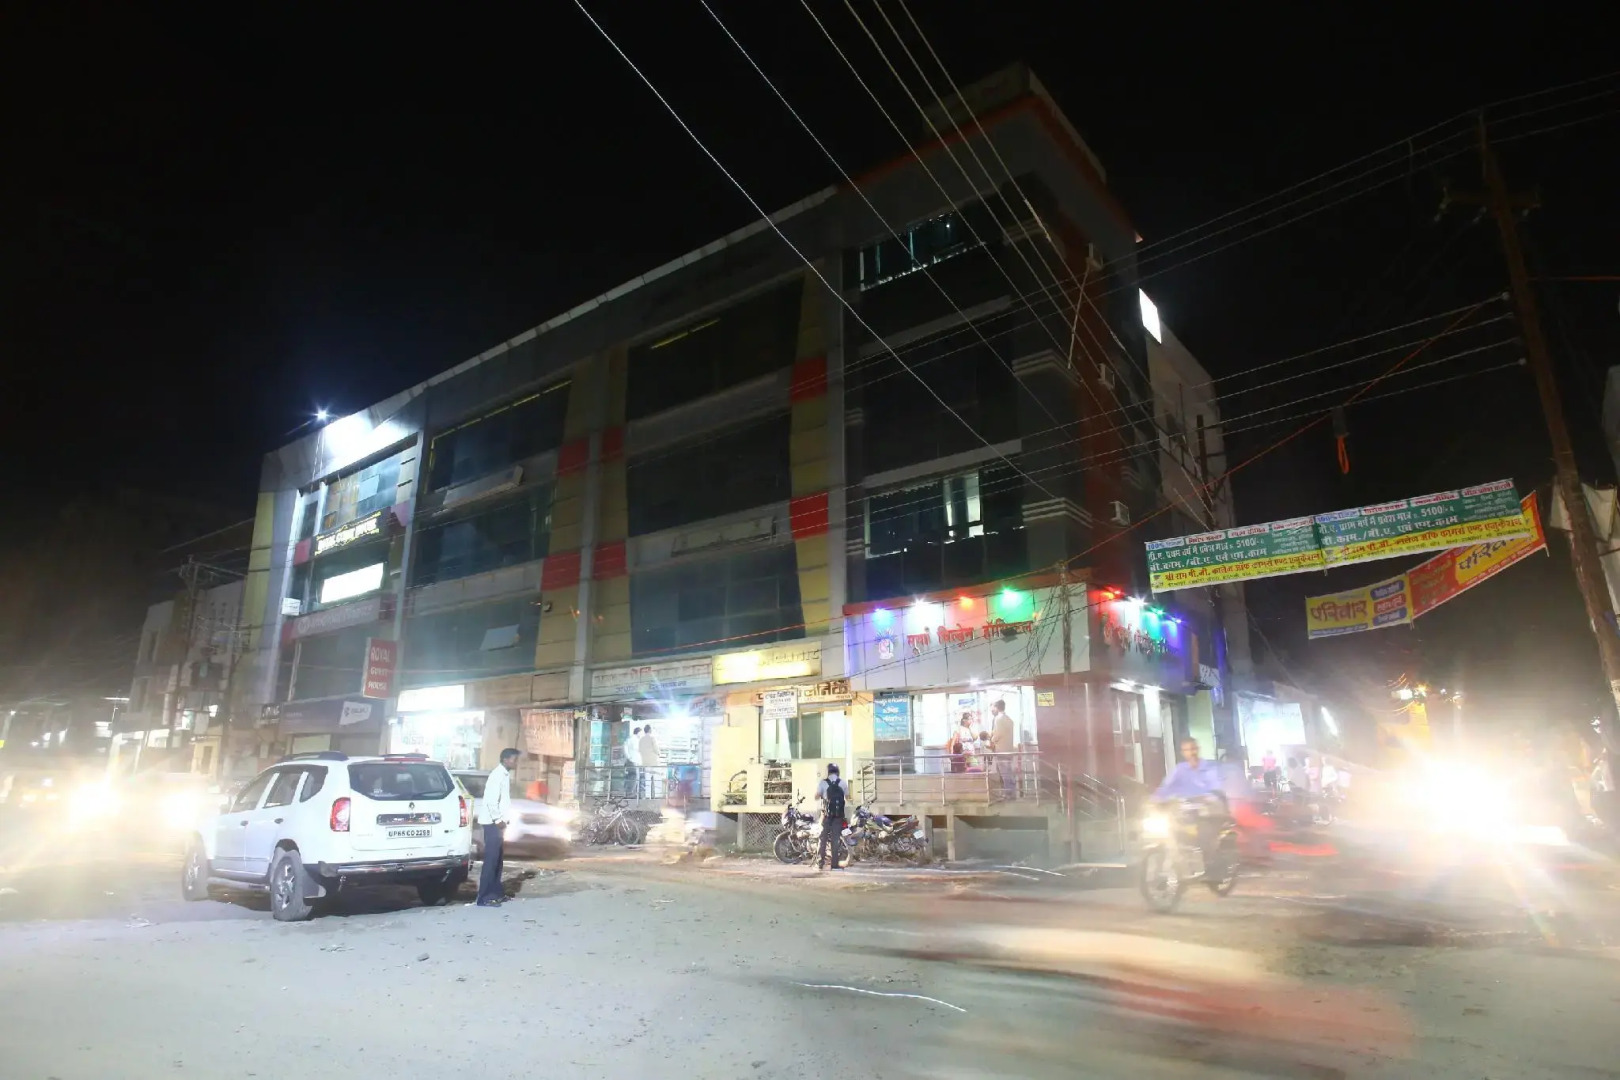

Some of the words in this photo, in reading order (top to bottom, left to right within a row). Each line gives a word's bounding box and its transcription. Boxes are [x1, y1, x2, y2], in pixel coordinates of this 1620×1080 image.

[1419, 503, 1448, 517] 5100/-
[1235, 536, 1260, 548] 5100/-
[1174, 571, 1187, 580] राम
[370, 645, 391, 664] ROYAL
